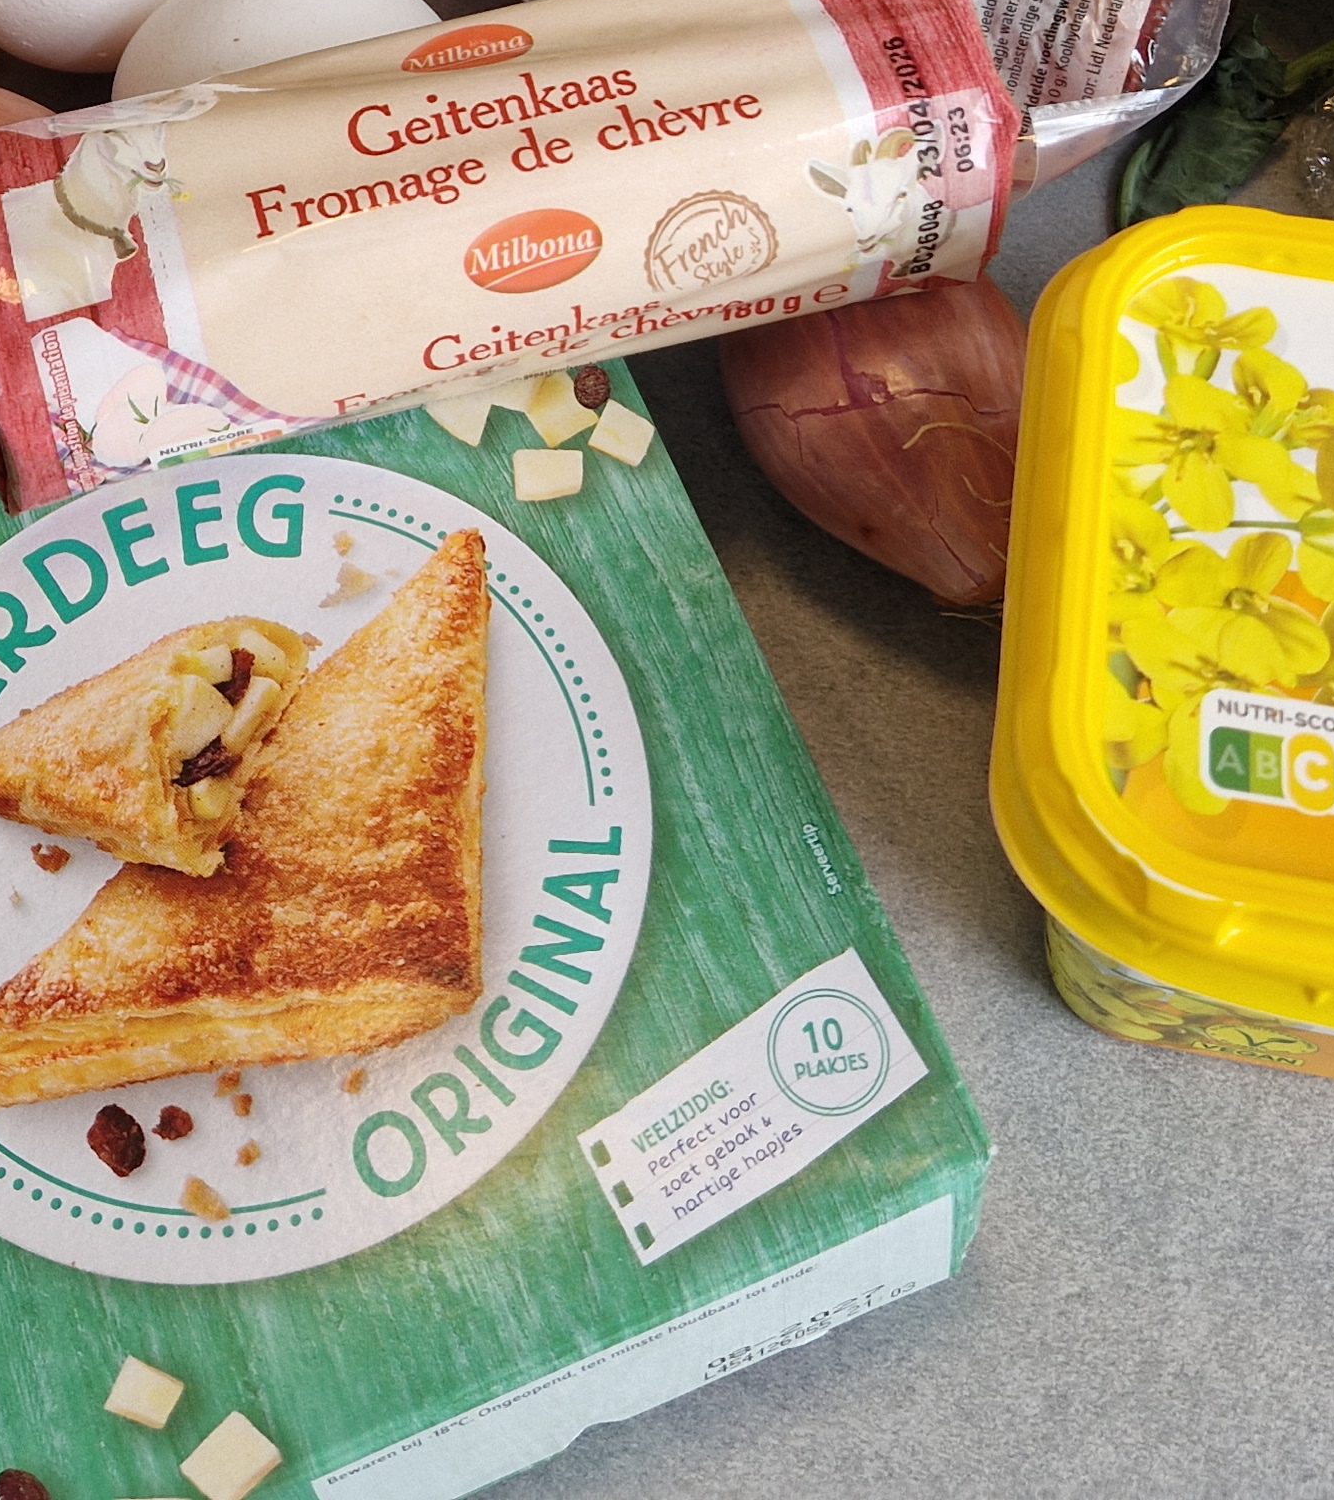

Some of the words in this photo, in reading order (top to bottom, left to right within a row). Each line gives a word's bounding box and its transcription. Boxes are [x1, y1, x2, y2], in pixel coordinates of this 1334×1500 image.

[1000, 0, 1019, 33] water.
[406, 32, 527, 73] Milbona
[1091, 51, 1107, 75] Lidl
[347, 67, 638, 156] Geitenkaas
[883, 35, 944, 177] 23/04/2026
[954, 106, 974, 174] 06:23
[246, 154, 488, 239] Fromage
[511, 126, 574, 175] de
[597, 91, 763, 151] chèvre
[469, 225, 595, 278] Milbona
[654, 200, 748, 285] French
[693, 245, 746, 289] Style
[422, 300, 661, 372] Geitenkaas
[722, 297, 776, 321] 180
[782, 295, 802, 315] g
[541, 337, 589, 359] de
[159, 427, 254, 456] NUTRI-SCORE
[802, 823, 842, 895] Serveertip
[351, 825, 623, 1201] ORIGINAL
[802, 1017, 844, 1054] 10
[794, 1053, 868, 1080] PLAKJES
[1191, 1041, 1304, 1066] VEGAN
[630, 1080, 734, 1153] VEELZIJDIG:
[647, 1123, 716, 1176] Perfect
[717, 1092, 759, 1126] voor
[660, 1163, 702, 1198] zoet
[705, 1125, 759, 1170] gebak
[761, 1115, 774, 1129] &
[671, 1167, 742, 1219] hartige
[744, 1121, 805, 1174] hapjes
[326, 1450, 397, 1486] Bewaren
[401, 1437, 423, 1453] bij
[581, 1356, 606, 1372] ten
[610, 1331, 664, 1359] minste
[667, 1298, 740, 1334] houdbaar
[746, 1286, 767, 1299] tot
